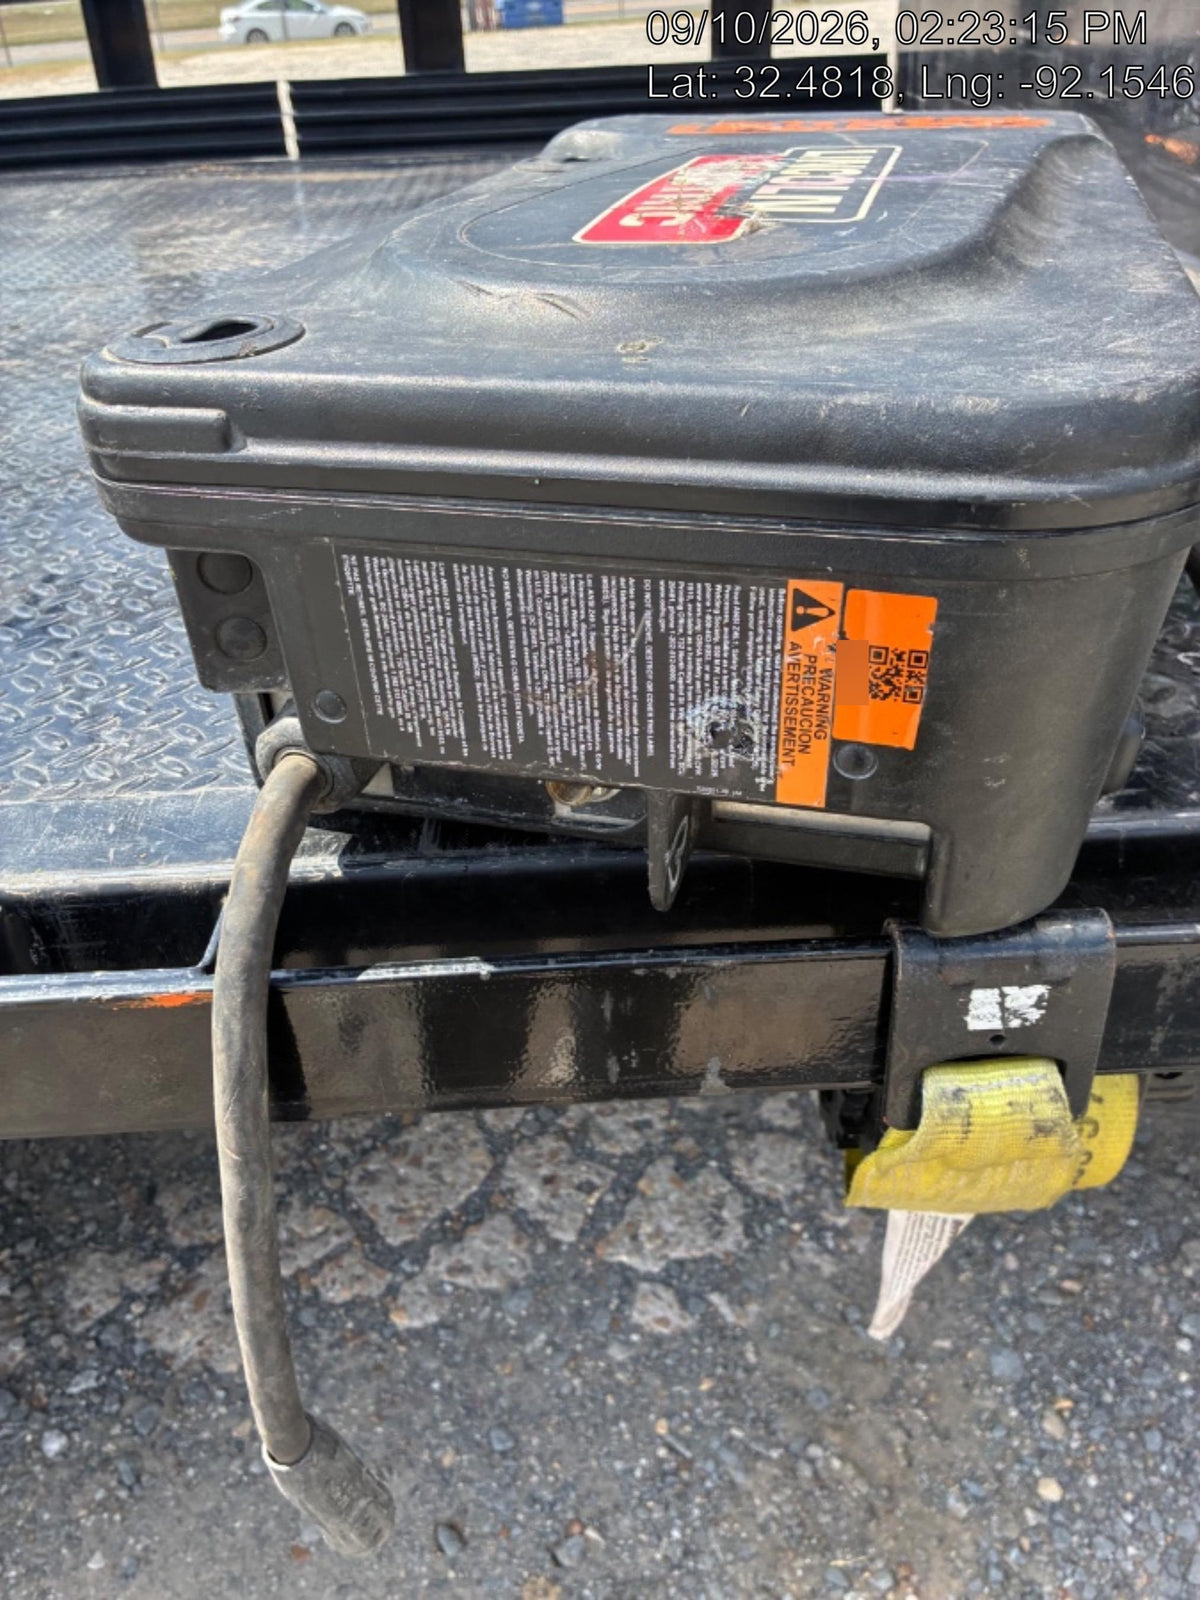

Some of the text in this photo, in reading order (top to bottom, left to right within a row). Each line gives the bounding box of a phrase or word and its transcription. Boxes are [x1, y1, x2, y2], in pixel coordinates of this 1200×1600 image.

[782, 641, 801, 766] AVERTISSEMENT
[797, 654, 816, 755] PRECAUCION
[814, 668, 832, 741] WARNING
